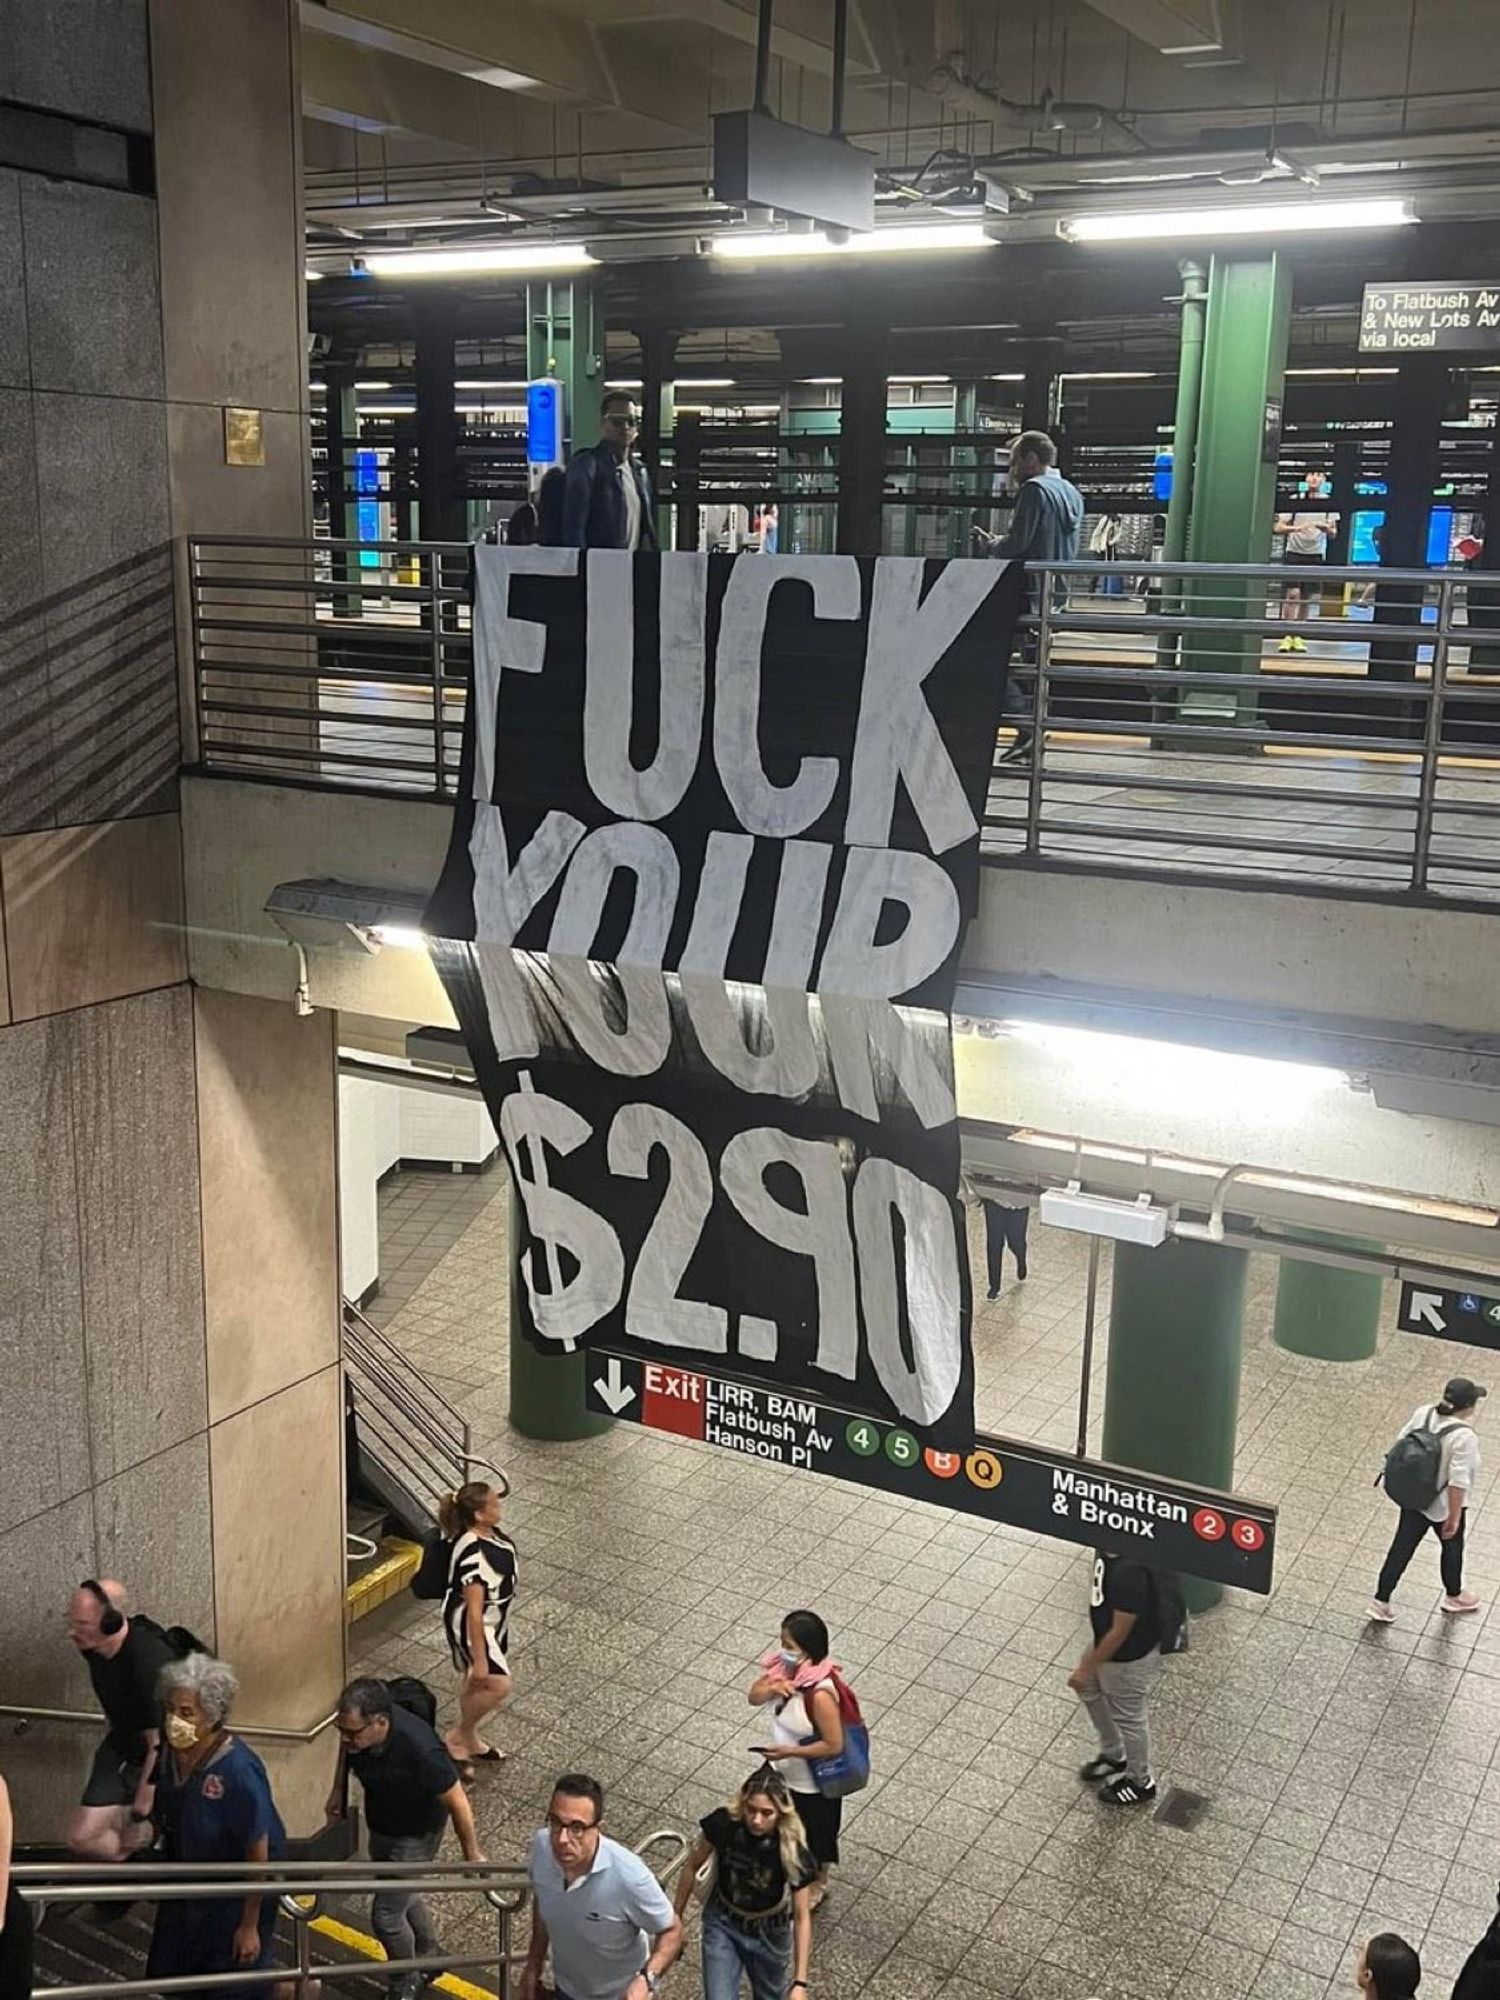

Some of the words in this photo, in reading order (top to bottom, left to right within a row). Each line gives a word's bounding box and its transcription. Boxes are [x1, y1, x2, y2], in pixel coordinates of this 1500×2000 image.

[1364, 312, 1377, 329] &
[1384, 311, 1425, 329] New
[1430, 310, 1471, 328] Lots
[1477, 309, 1500, 327] Av
[1366, 294, 1387, 311] To
[1393, 292, 1470, 310] Flatbush
[1475, 291, 1500, 308] Av
[1361, 331, 1387, 347] via
[1393, 329, 1436, 347] local
[473, 544, 1012, 855] FUCK
[468, 802, 961, 1129] YOUR
[499, 1069, 962, 1426] $2.90
[1489, 1305, 1500, 1322] 4
[644, 1365, 701, 1404] Exit
[706, 1380, 760, 1414] LIRR,
[767, 1397, 817, 1426] BAM
[705, 1403, 797, 1443] Flatbush
[806, 1429, 834, 1452] Av
[705, 1422, 783, 1461] Hanson
[792, 1447, 813, 1469] Pl
[854, 1428, 870, 1449] 4
[893, 1437, 910, 1459] 5
[935, 1452, 951, 1470] B
[974, 1459, 993, 1481] Q
[1052, 1469, 1188, 1523] Manhattan
[1052, 1493, 1069, 1516] &
[1080, 1500, 1155, 1539] Bronx
[1202, 1516, 1217, 1535] 2
[1240, 1525, 1256, 1544] 3
